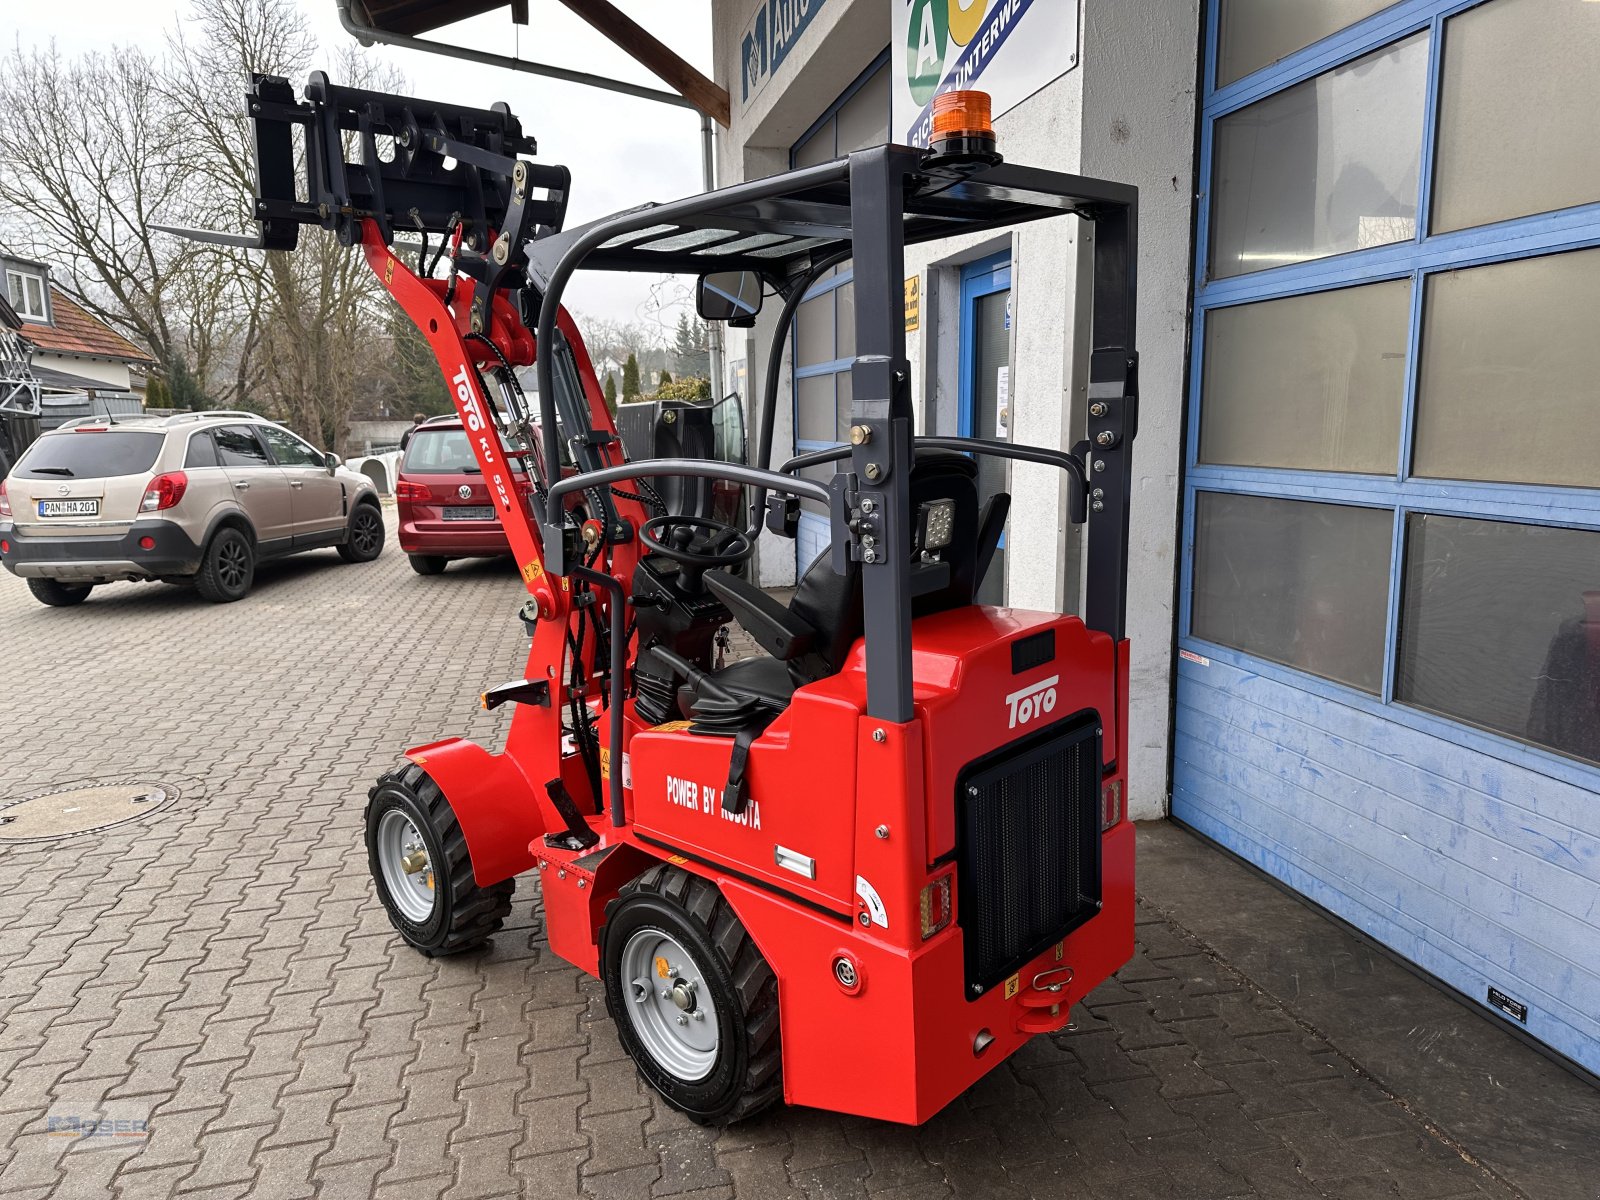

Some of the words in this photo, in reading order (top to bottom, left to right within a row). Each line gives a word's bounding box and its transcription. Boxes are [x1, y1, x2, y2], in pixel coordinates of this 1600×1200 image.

[453, 364, 486, 432] TOYO
[479, 437, 494, 463] KU
[493, 474, 510, 506] 522
[45, 502, 60, 513] PAN
[66, 502, 78, 513] HA
[79, 501, 96, 512] 201
[1006, 674, 1059, 729] TOYO
[666, 775, 698, 811] POWER
[703, 785, 715, 816] BY
